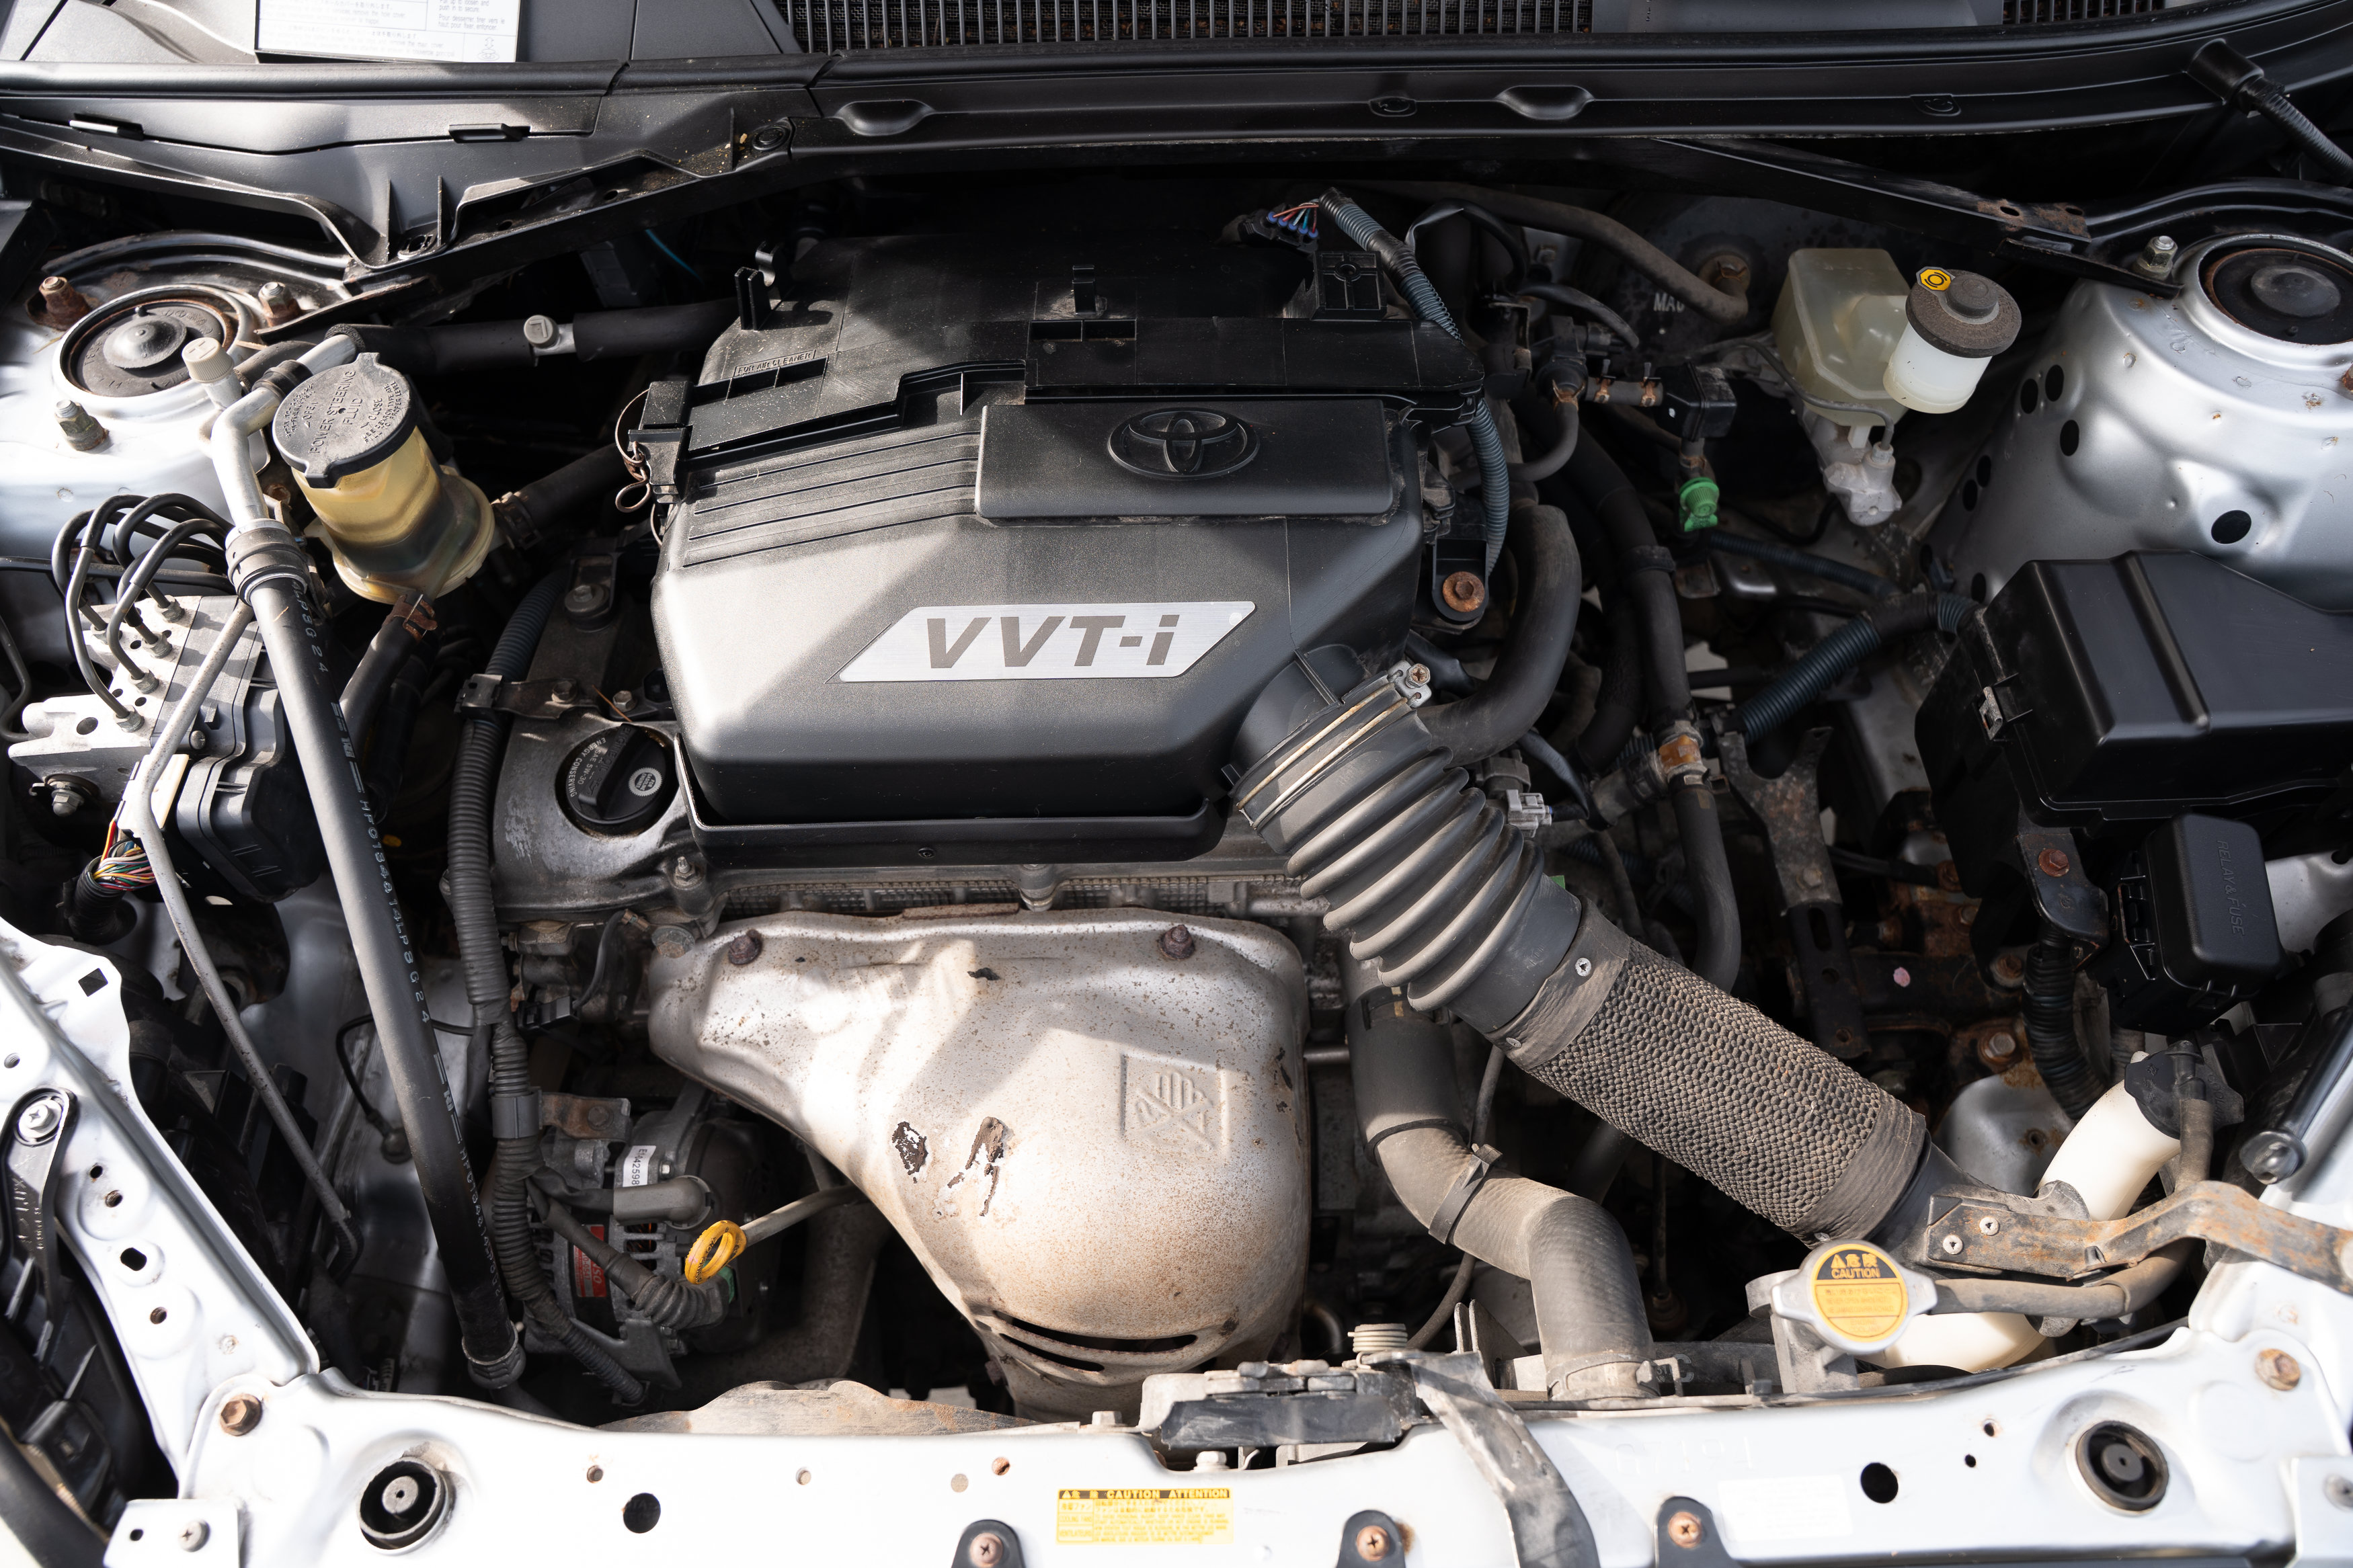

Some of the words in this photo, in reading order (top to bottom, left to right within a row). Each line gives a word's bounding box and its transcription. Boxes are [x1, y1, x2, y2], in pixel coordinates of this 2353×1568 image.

[772, 353, 811, 366] CLEANER
[310, 417, 334, 454] POWER
[327, 370, 356, 416] STEERING
[342, 398, 363, 425] FLUID
[368, 397, 383, 421] CLOSE
[926, 614, 1179, 668] VVT-i
[581, 737, 606, 757] ENERGY
[590, 749, 601, 762] SAE
[567, 757, 584, 798] CONSERVING
[577, 764, 594, 785] 5W-30
[2217, 840, 2235, 884] RELAY
[2227, 897, 2245, 936] FUSE
[1831, 1268, 1881, 1279] CAUTION
[1107, 1489, 1160, 1499] CAUTION
[1168, 1489, 1228, 1499] ATTENTION
